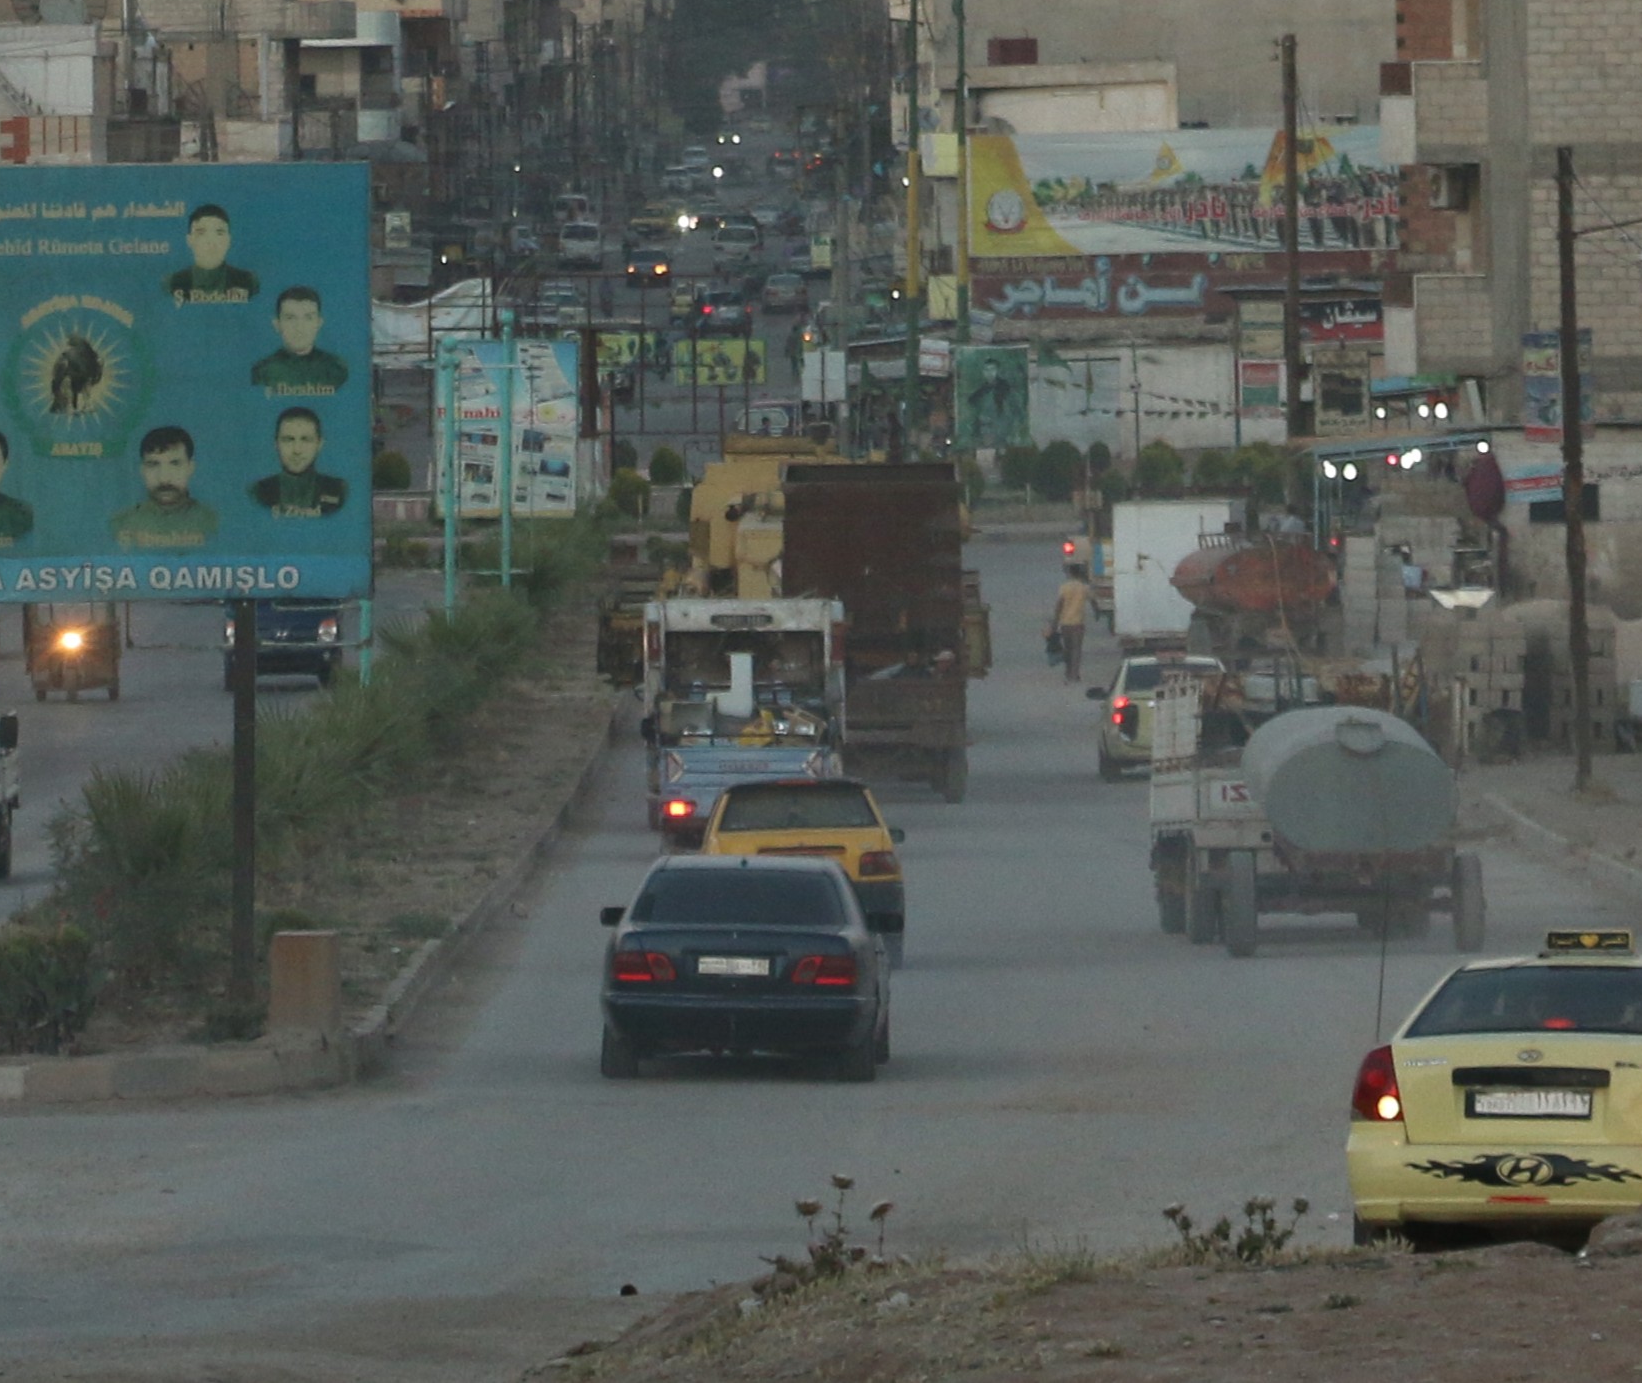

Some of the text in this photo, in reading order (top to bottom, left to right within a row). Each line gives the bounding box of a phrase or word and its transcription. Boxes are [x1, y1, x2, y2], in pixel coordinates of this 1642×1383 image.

[985, 256, 1208, 315] لن أهاجر
[15, 563, 137, 599] ASYÎŞA
[149, 564, 300, 599] QAMIŞLO
